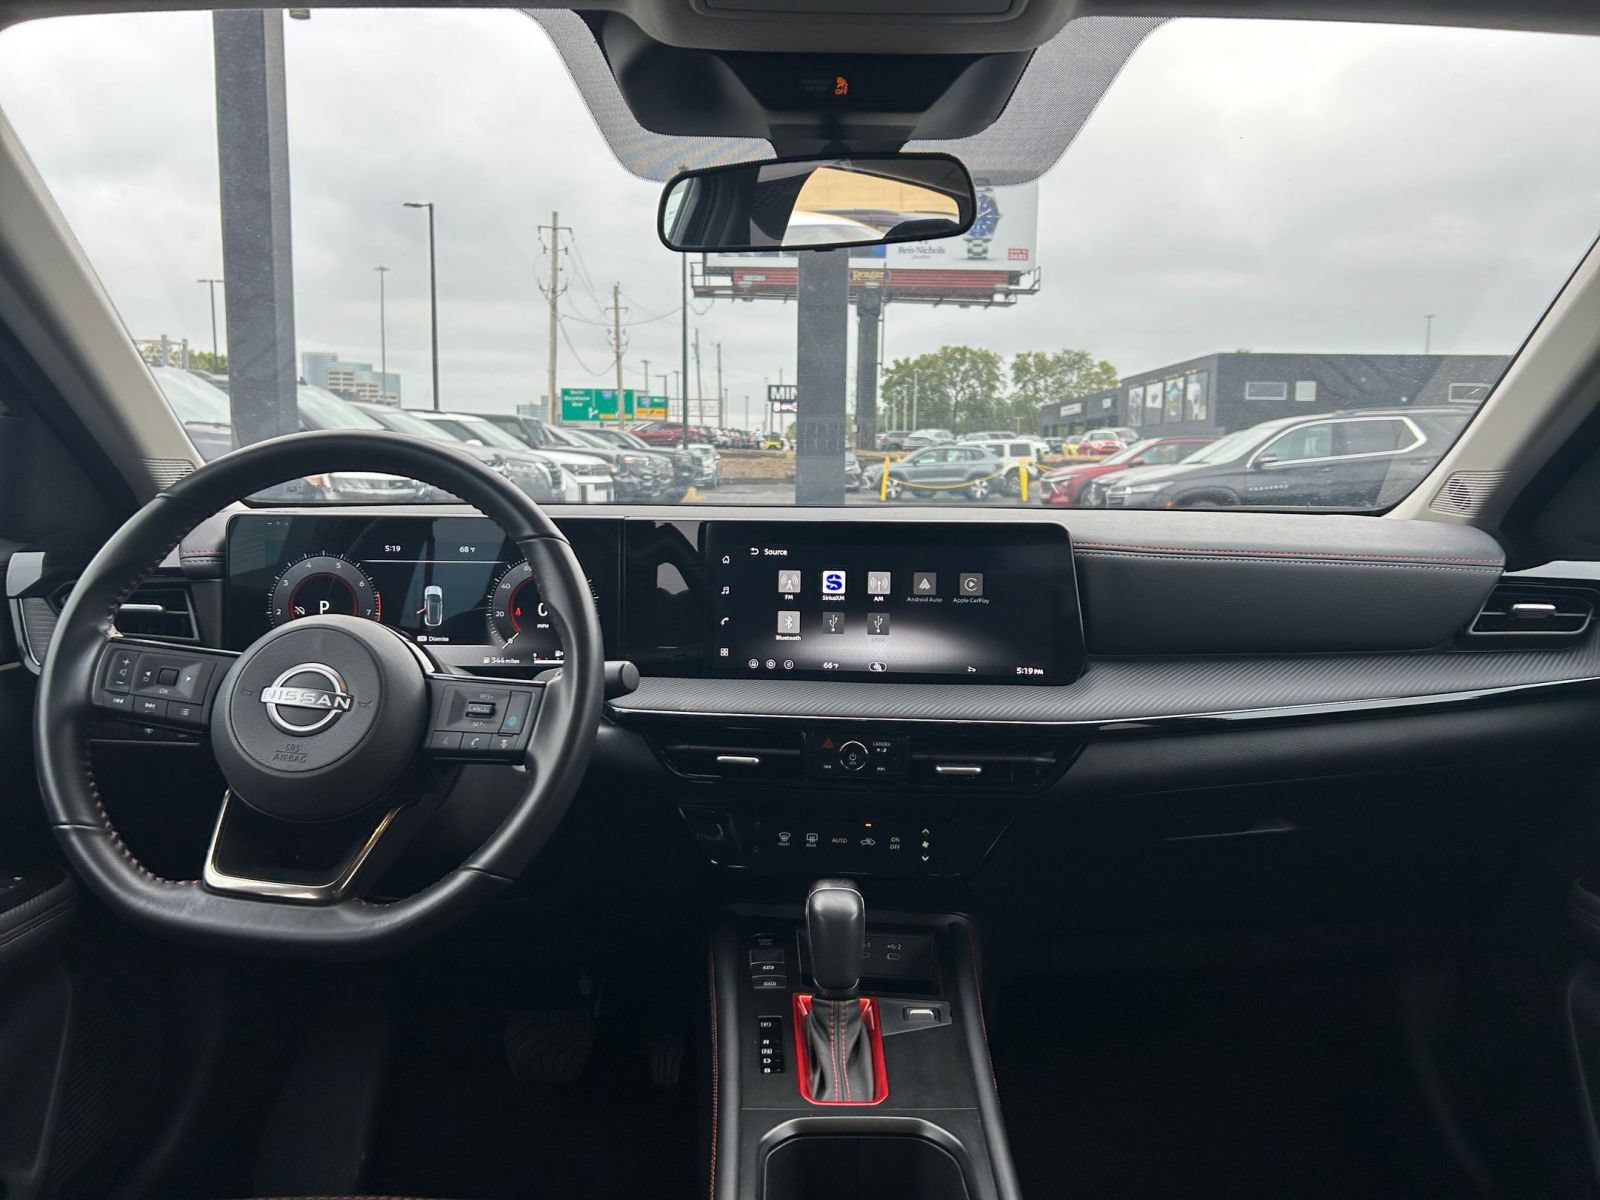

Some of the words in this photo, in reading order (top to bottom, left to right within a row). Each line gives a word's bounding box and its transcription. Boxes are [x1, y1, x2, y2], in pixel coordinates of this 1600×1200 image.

[764, 548, 788, 556] Source
[320, 600, 330, 615] P
[263, 688, 352, 709] NISSAN
[273, 754, 308, 764] AIRBAG
